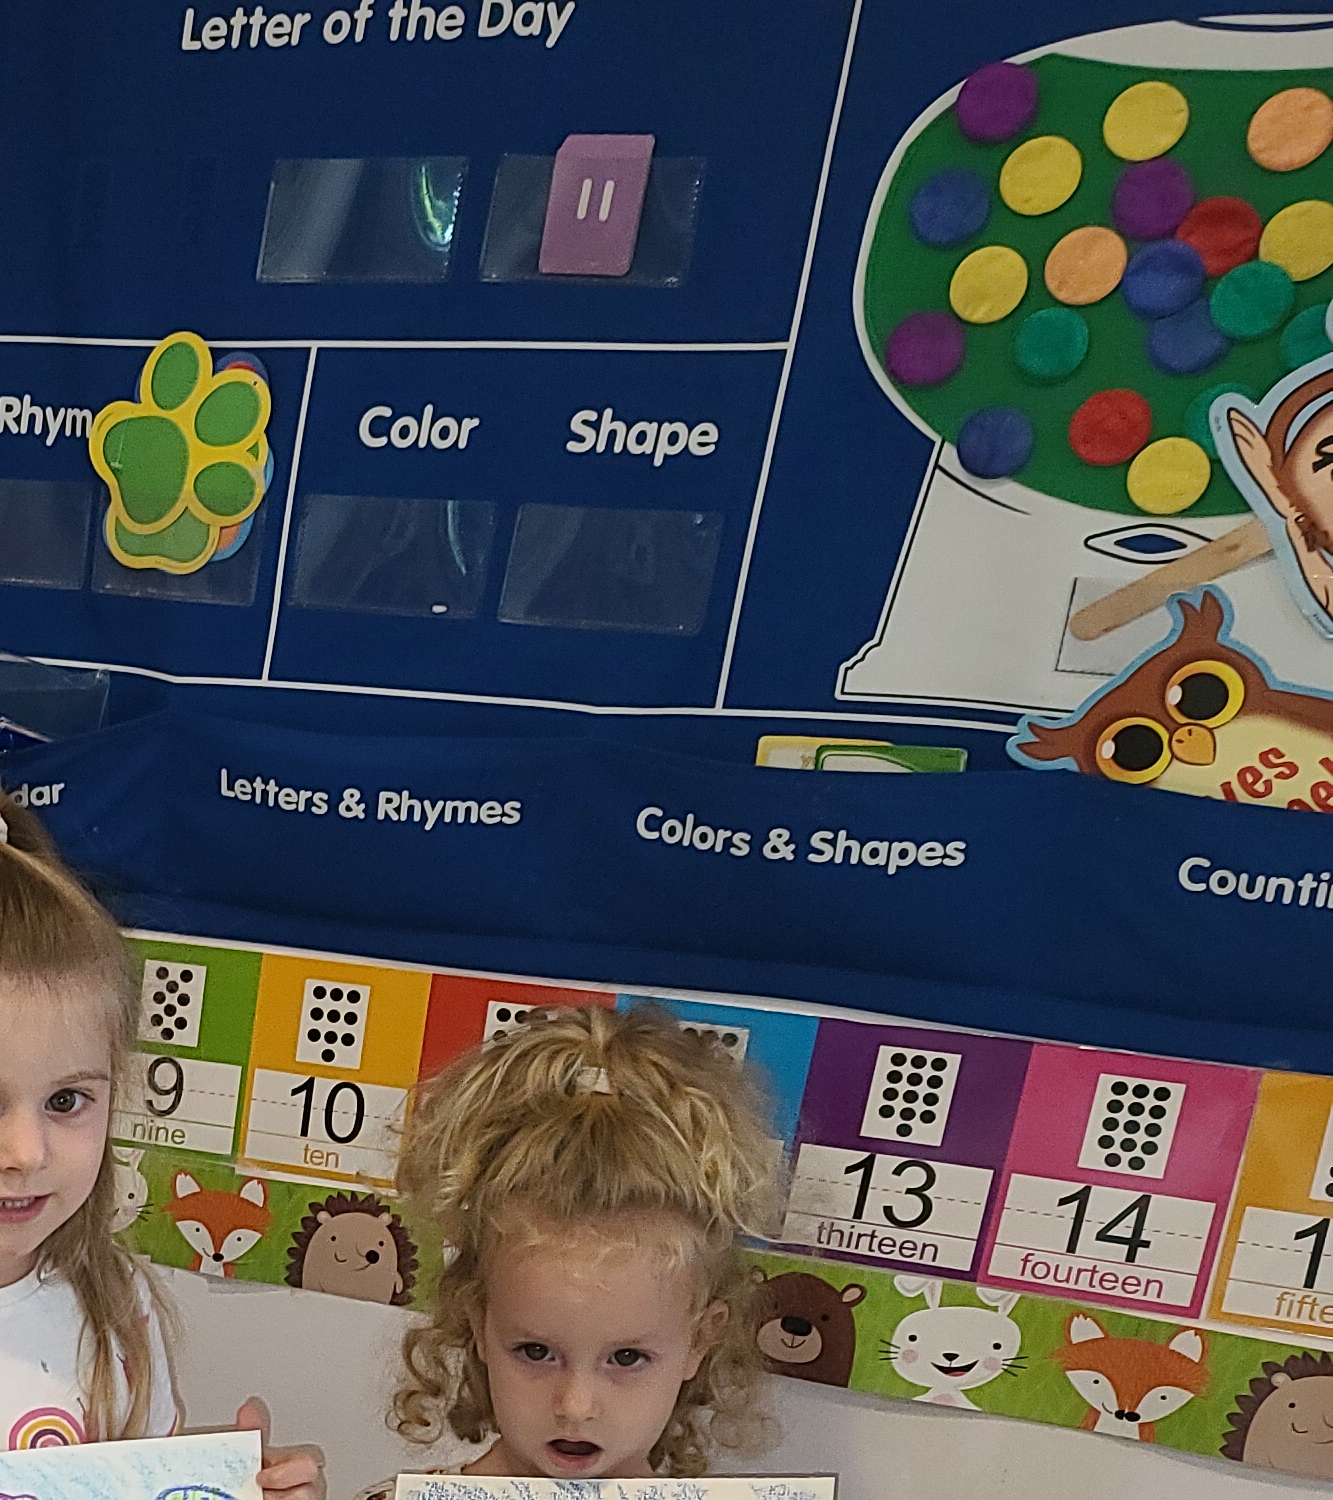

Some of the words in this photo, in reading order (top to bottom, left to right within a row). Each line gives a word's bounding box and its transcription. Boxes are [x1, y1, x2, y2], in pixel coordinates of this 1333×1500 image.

[181, 6, 312, 51] Letter
[323, 0, 374, 44] of
[388, 0, 466, 41] the
[477, 0, 576, 49] Day
[358, 404, 480, 452] Color
[566, 407, 719, 467] Shape
[220, 767, 330, 816] Letters
[338, 788, 366, 820] &
[377, 790, 522, 831] Rhymes
[636, 806, 751, 858] Colors
[762, 828, 795, 861] &
[807, 829, 966, 875] Shapes
[1178, 856, 1333, 909] Counti
[145, 1056, 184, 1117] 9
[290, 1076, 365, 1145] 10
[132, 1118, 186, 1145] nine
[302, 1143, 340, 1170] ten
[842, 1152, 937, 1229] 13
[816, 1219, 940, 1264] thirteen
[1055, 1184, 1153, 1264] 14
[1020, 1252, 1165, 1300] fourteen
[1293, 1217, 1331, 1289] 1
[1274, 1291, 1333, 1324] fifte
